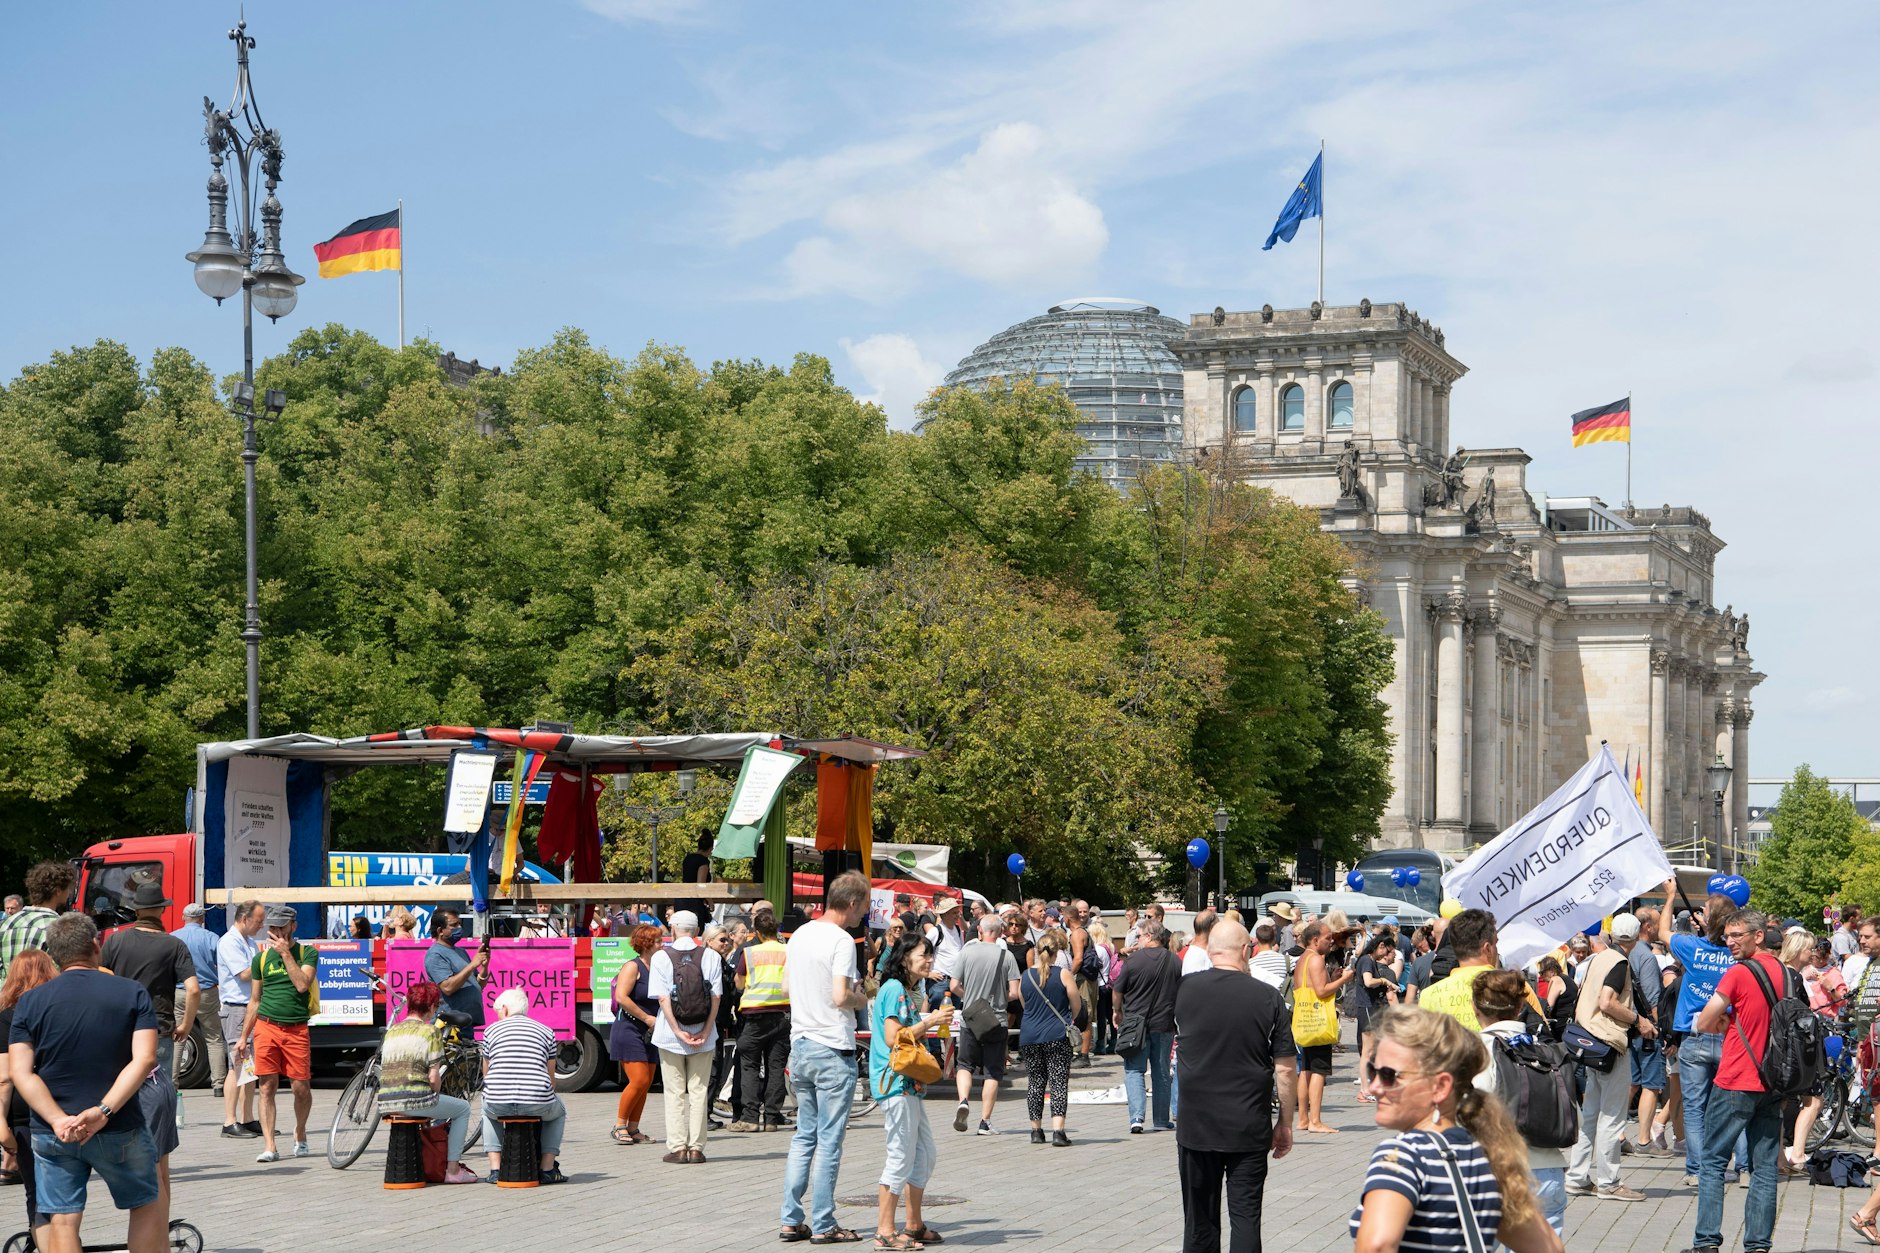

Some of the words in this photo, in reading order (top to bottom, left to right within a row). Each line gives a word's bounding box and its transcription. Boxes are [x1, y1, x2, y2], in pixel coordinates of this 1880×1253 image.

[320, 956, 368, 966] Transparenz
[1694, 948, 1737, 964] Freihe
[329, 968, 352, 978] statt
